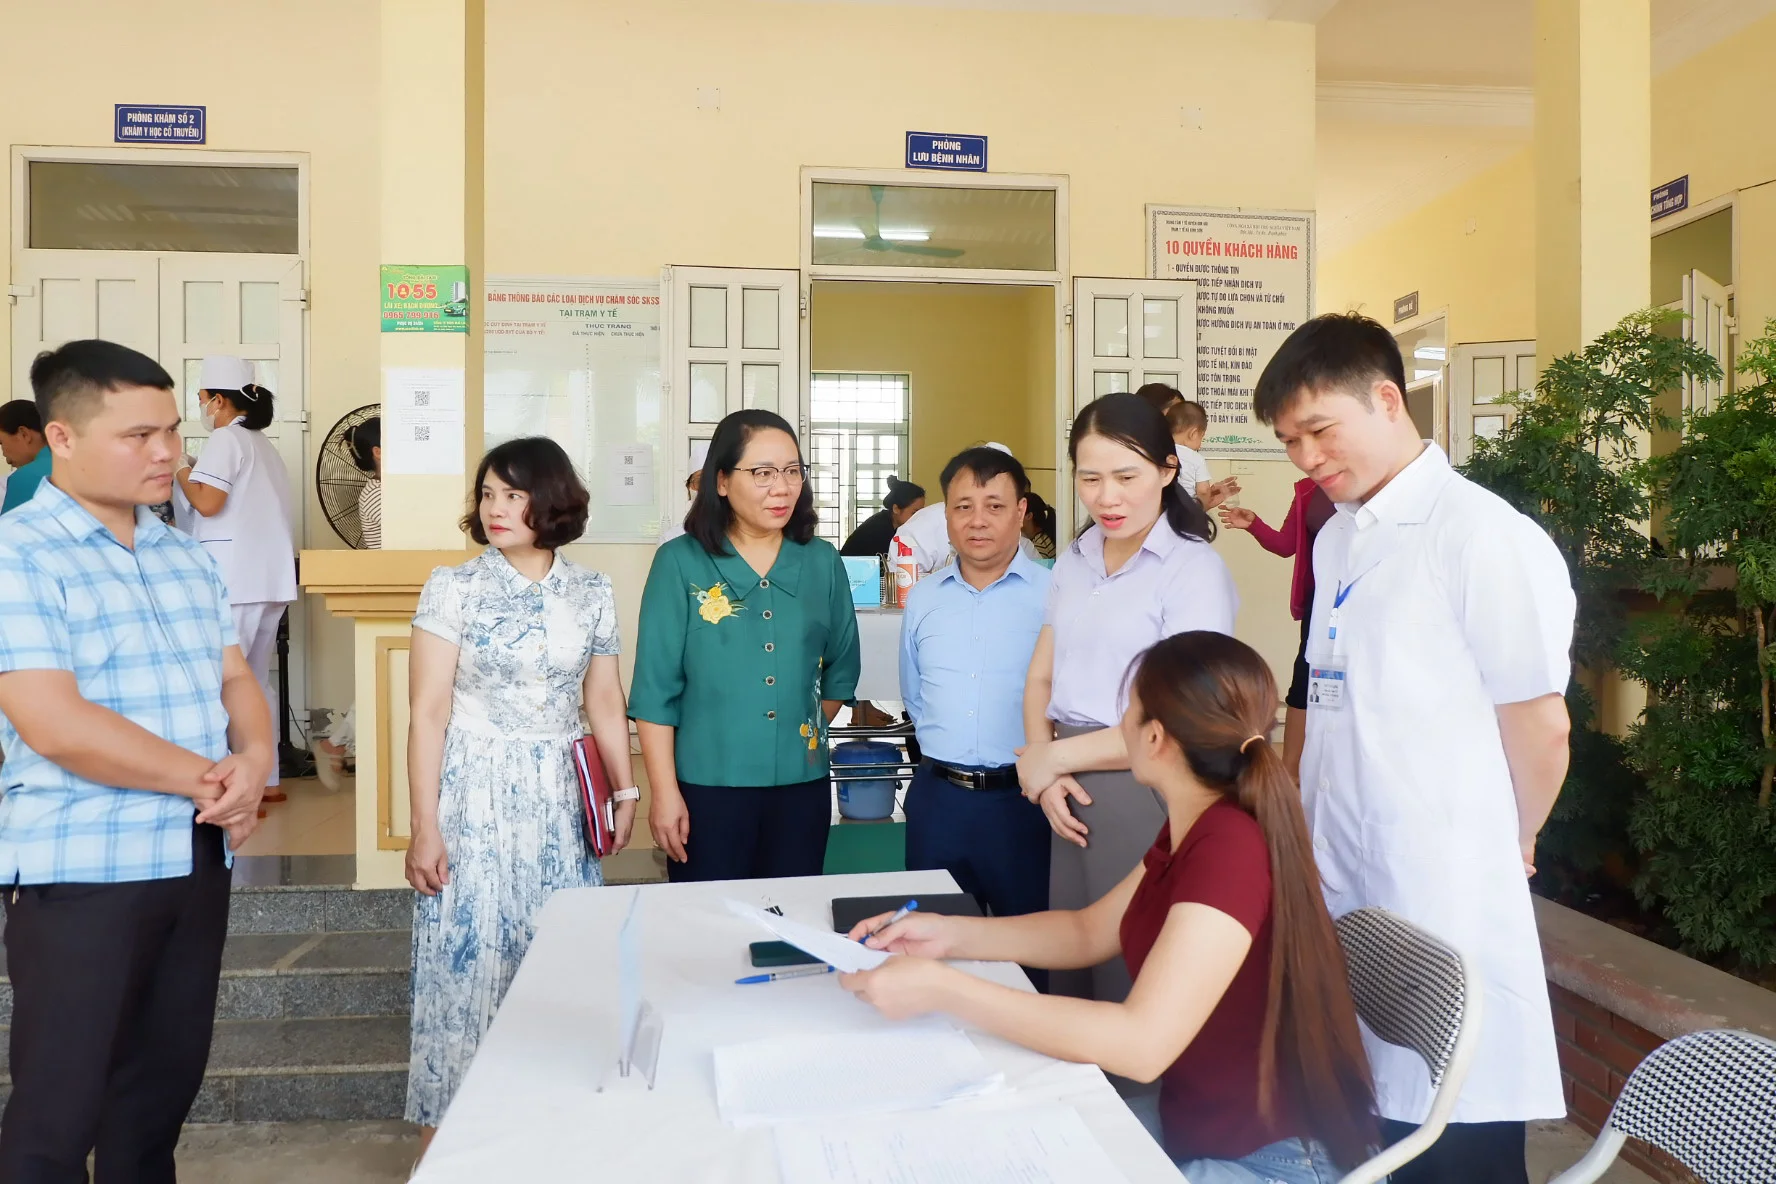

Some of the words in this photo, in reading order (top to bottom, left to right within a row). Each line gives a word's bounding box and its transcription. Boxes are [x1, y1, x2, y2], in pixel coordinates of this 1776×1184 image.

[127, 111, 153, 123] PHÒNG
[154, 112, 176, 124] KHÁM
[177, 111, 188, 124] SỐ
[189, 114, 195, 124] 2
[122, 125, 143, 137] (KHÁM
[144, 127, 149, 137] Y
[149, 127, 163, 139] HỌC
[163, 124, 173, 137] CỔ
[932, 139, 961, 151] PHÒNG
[913, 152, 930, 162] LƯU
[931, 152, 954, 165] BỆNH
[955, 153, 980, 165] NHÂN
[1166, 240, 1180, 255] 10
[1183, 237, 1221, 257] QUYỀN
[1224, 240, 1263, 259] KHÁCH
[1266, 241, 1298, 260] HÀNG
[1175, 262, 1194, 273] QUYỀN
[1211, 265, 1229, 275] THÔNG
[1230, 266, 1240, 275] TIN
[1211, 276, 1223, 288] TIẾP
[1240, 280, 1254, 291] DỊCH
[1254, 280, 1263, 291] VỤ
[387, 282, 438, 300] 1055
[488, 289, 507, 302] BẢNG
[508, 291, 530, 303] THÔNG
[531, 292, 545, 303] BÁO
[546, 292, 560, 303] CÁC
[561, 294, 577, 306] LOẠI
[578, 295, 594, 306] DỊCH
[595, 295, 604, 306] VỤ
[627, 294, 640, 305] SÓC
[641, 296, 660, 305] SKSS
[1240, 293, 1255, 304] CHỌN
[1255, 293, 1263, 303] VÀ
[383, 311, 404, 319] 0965
[559, 309, 573, 319] TẠI
[575, 309, 598, 320] TRẠM
[607, 308, 618, 318] TẾ
[1253, 321, 1261, 330] AN
[1197, 359, 1210, 370] ƯỢC
[1211, 358, 1217, 369] TẾ
[1197, 373, 1210, 383] ƯỢC
[1222, 374, 1241, 385] TRỌNG
[1198, 386, 1210, 397] ƯỢC
